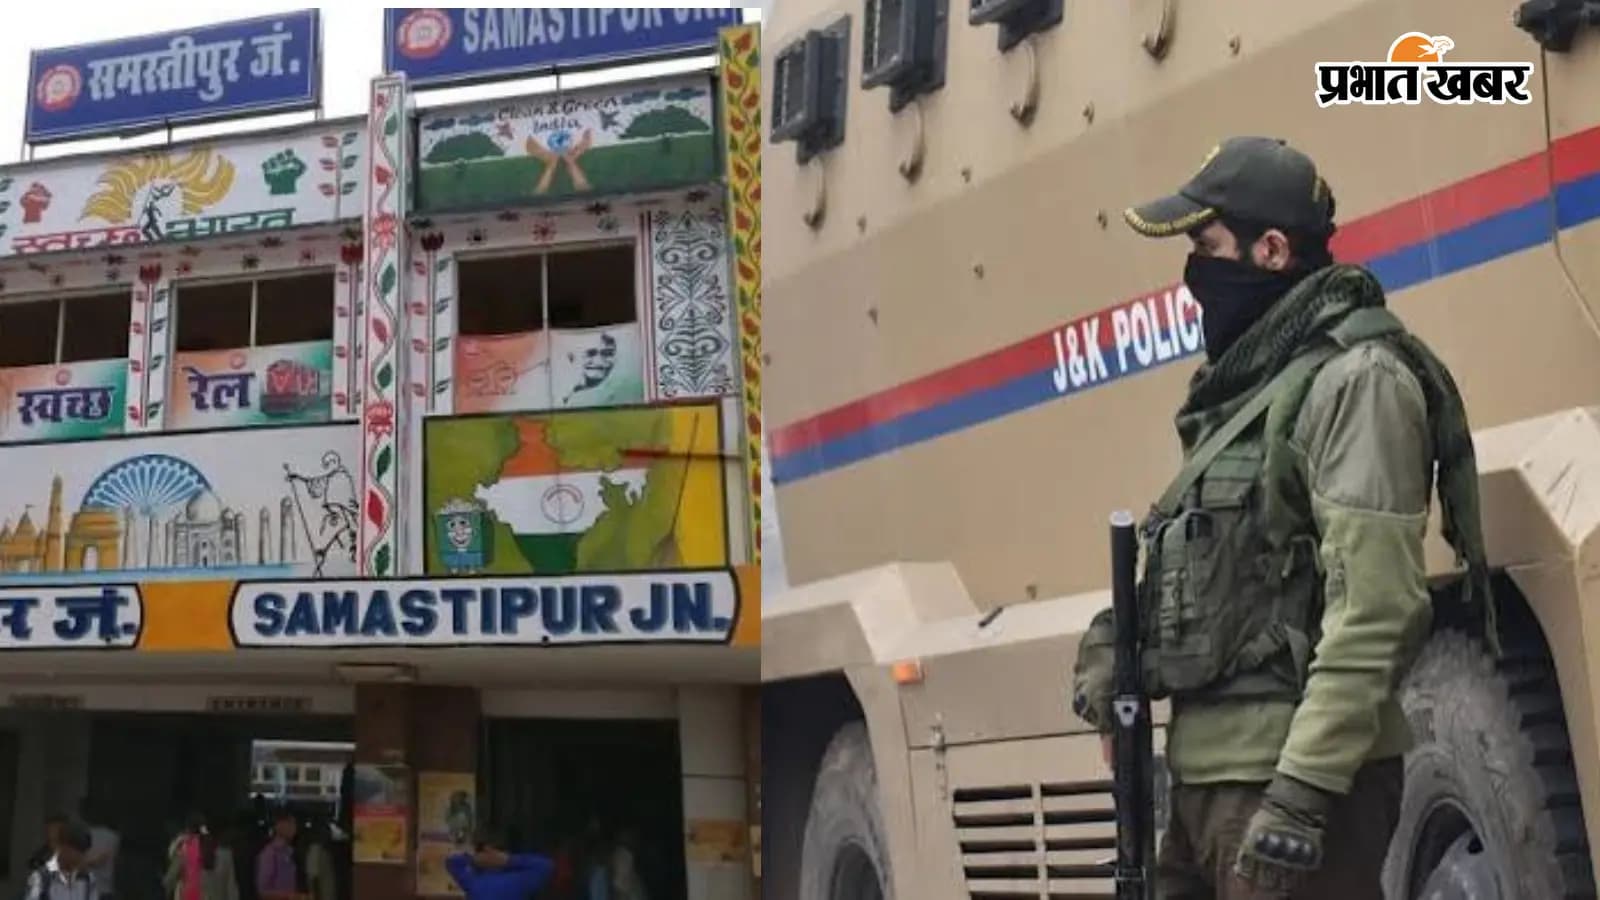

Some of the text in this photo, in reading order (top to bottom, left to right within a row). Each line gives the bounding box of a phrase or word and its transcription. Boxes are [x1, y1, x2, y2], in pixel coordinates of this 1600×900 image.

[87, 22, 300, 101] समस्तीपुर जं.
[533, 116, 583, 133] India
[1053, 284, 1206, 393] J&K POLIC
[16, 385, 116, 425] स्वच्छ
[182, 366, 256, 411] रेल
[253, 582, 732, 638] SAMASTIPUR JN.
